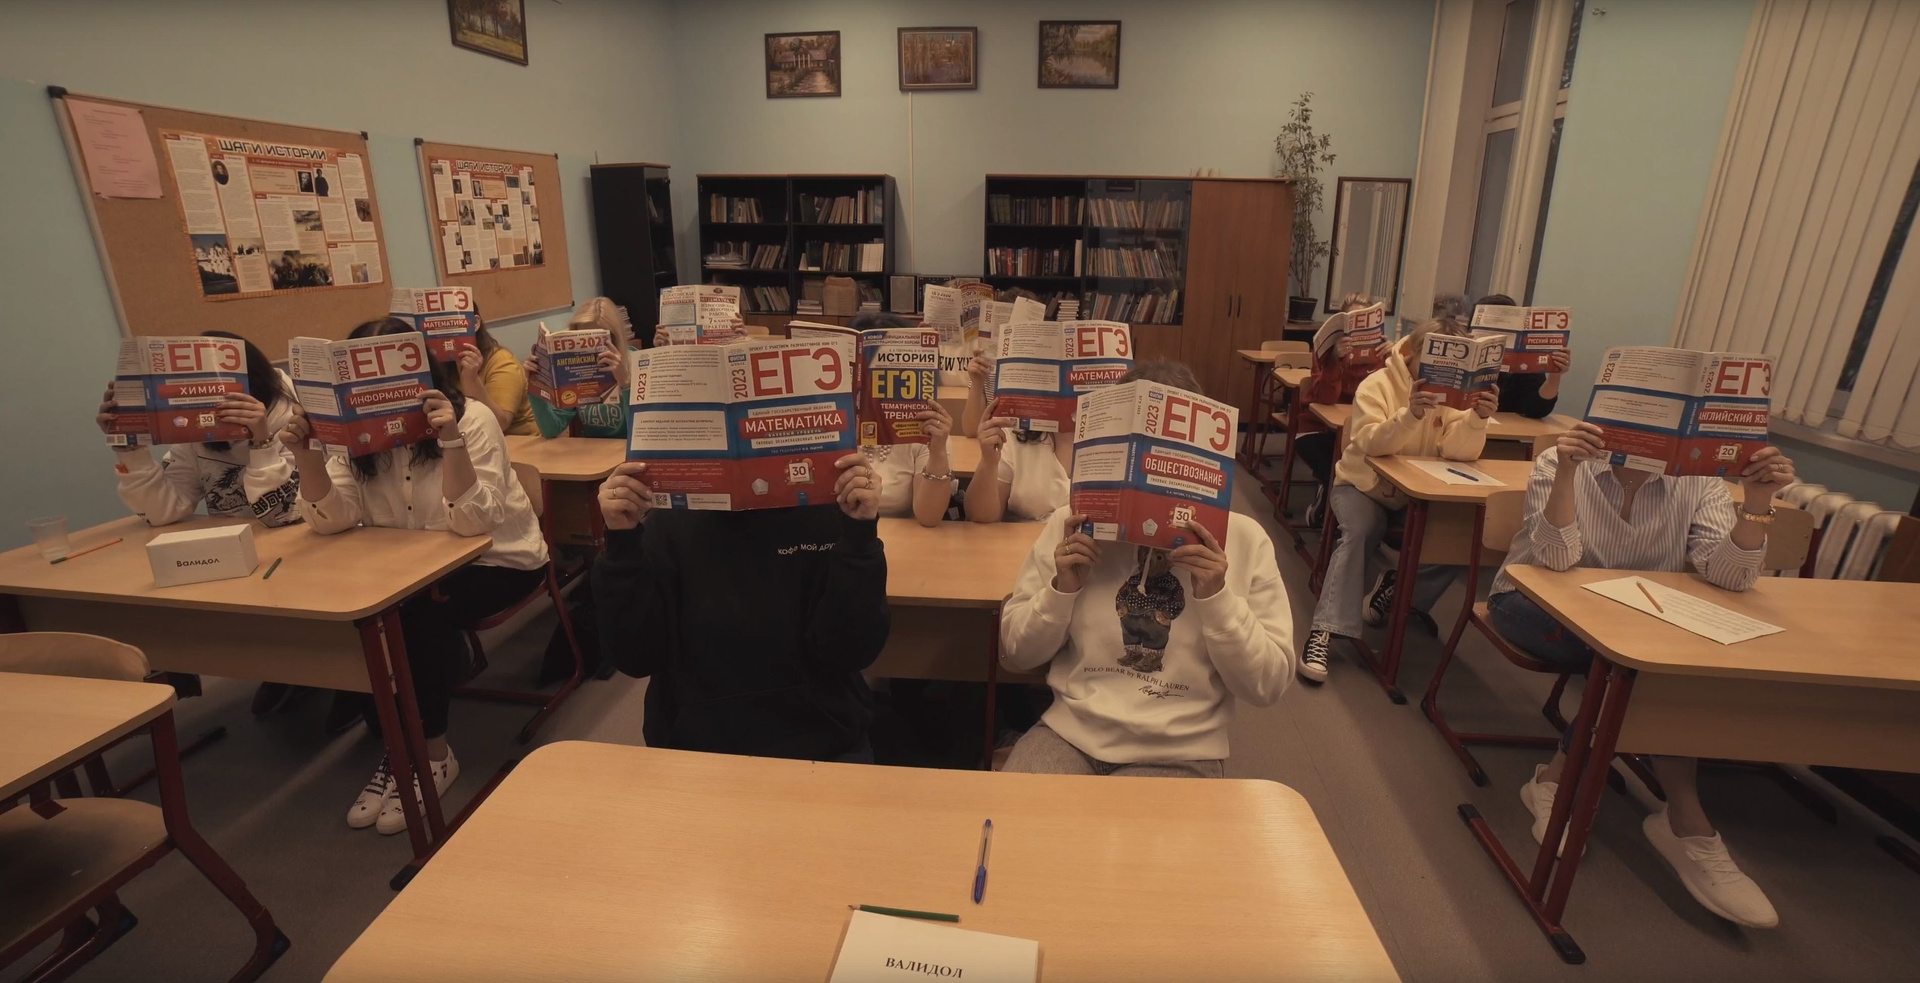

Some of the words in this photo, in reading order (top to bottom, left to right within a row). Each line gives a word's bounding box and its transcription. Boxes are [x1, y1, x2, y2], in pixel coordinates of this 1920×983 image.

[218, 139, 263, 154] ШАГИ
[265, 144, 327, 161] ИСТОРИИ
[456, 160, 479, 171] ШАГИ
[481, 163, 514, 174] ИСТОРИИ
[416, 299, 425, 313] 2023
[425, 291, 469, 312] ЕГЭ
[423, 319, 469, 329] МАТЕМАТИКА
[1354, 308, 1383, 329] ЕГЭ
[1532, 312, 1568, 329] ЕГЭ
[922, 335, 936, 345] ЕГЭ
[1002, 337, 1011, 357] 2023
[1065, 337, 1075, 358] 2023
[1077, 327, 1129, 357] ЕГЭ
[1426, 338, 1470, 360] ЕГЭ
[152, 352, 166, 373] 2023
[167, 343, 241, 372] ЕГЭ
[349, 342, 422, 379] ЕГЭ
[557, 355, 596, 366] АНГЛИЙСКИЙ
[878, 353, 935, 363] ИСТОРИЯ
[939, 356, 955, 371] EW
[1477, 344, 1504, 367] ЕГЭ
[292, 357, 301, 378] 2023
[337, 360, 351, 382] 2023
[749, 347, 843, 397] ЕГЭ
[1070, 371, 1126, 381] МАТЕМАТИ
[1601, 362, 1616, 383] 2023
[636, 372, 647, 401] 2023
[732, 368, 749, 399] 2023
[872, 370, 917, 400] ЕГЭ
[922, 371, 935, 400] 2022
[1704, 371, 1715, 394] 2023
[1713, 361, 1772, 396] ЕГЭ
[180, 385, 226, 395] ХИМИЯ
[349, 387, 425, 406] ИНФОРМАТИКА
[389, 422, 401, 430] 20
[745, 413, 843, 433] МАТЕМАТИКА
[884, 411, 920, 420] ТРЕНА
[1078, 413, 1088, 439] 2023
[1145, 404, 1159, 435] 2023
[1161, 395, 1231, 451] ЕГЭ
[1698, 410, 1753, 423] АНГЛИЙСКИЙ
[1721, 447, 1735, 456] 20
[792, 466, 806, 476] 30
[1145, 457, 1223, 487] ОБЩЕСТВОЗНАНИЕ
[1176, 510, 1190, 522] 30
[176, 558, 220, 568] Валидол
[1136, 672, 1158, 685] RALPH
[1159, 679, 1190, 691] LAUREN
[885, 957, 963, 979] ВАЛИДОЛ
